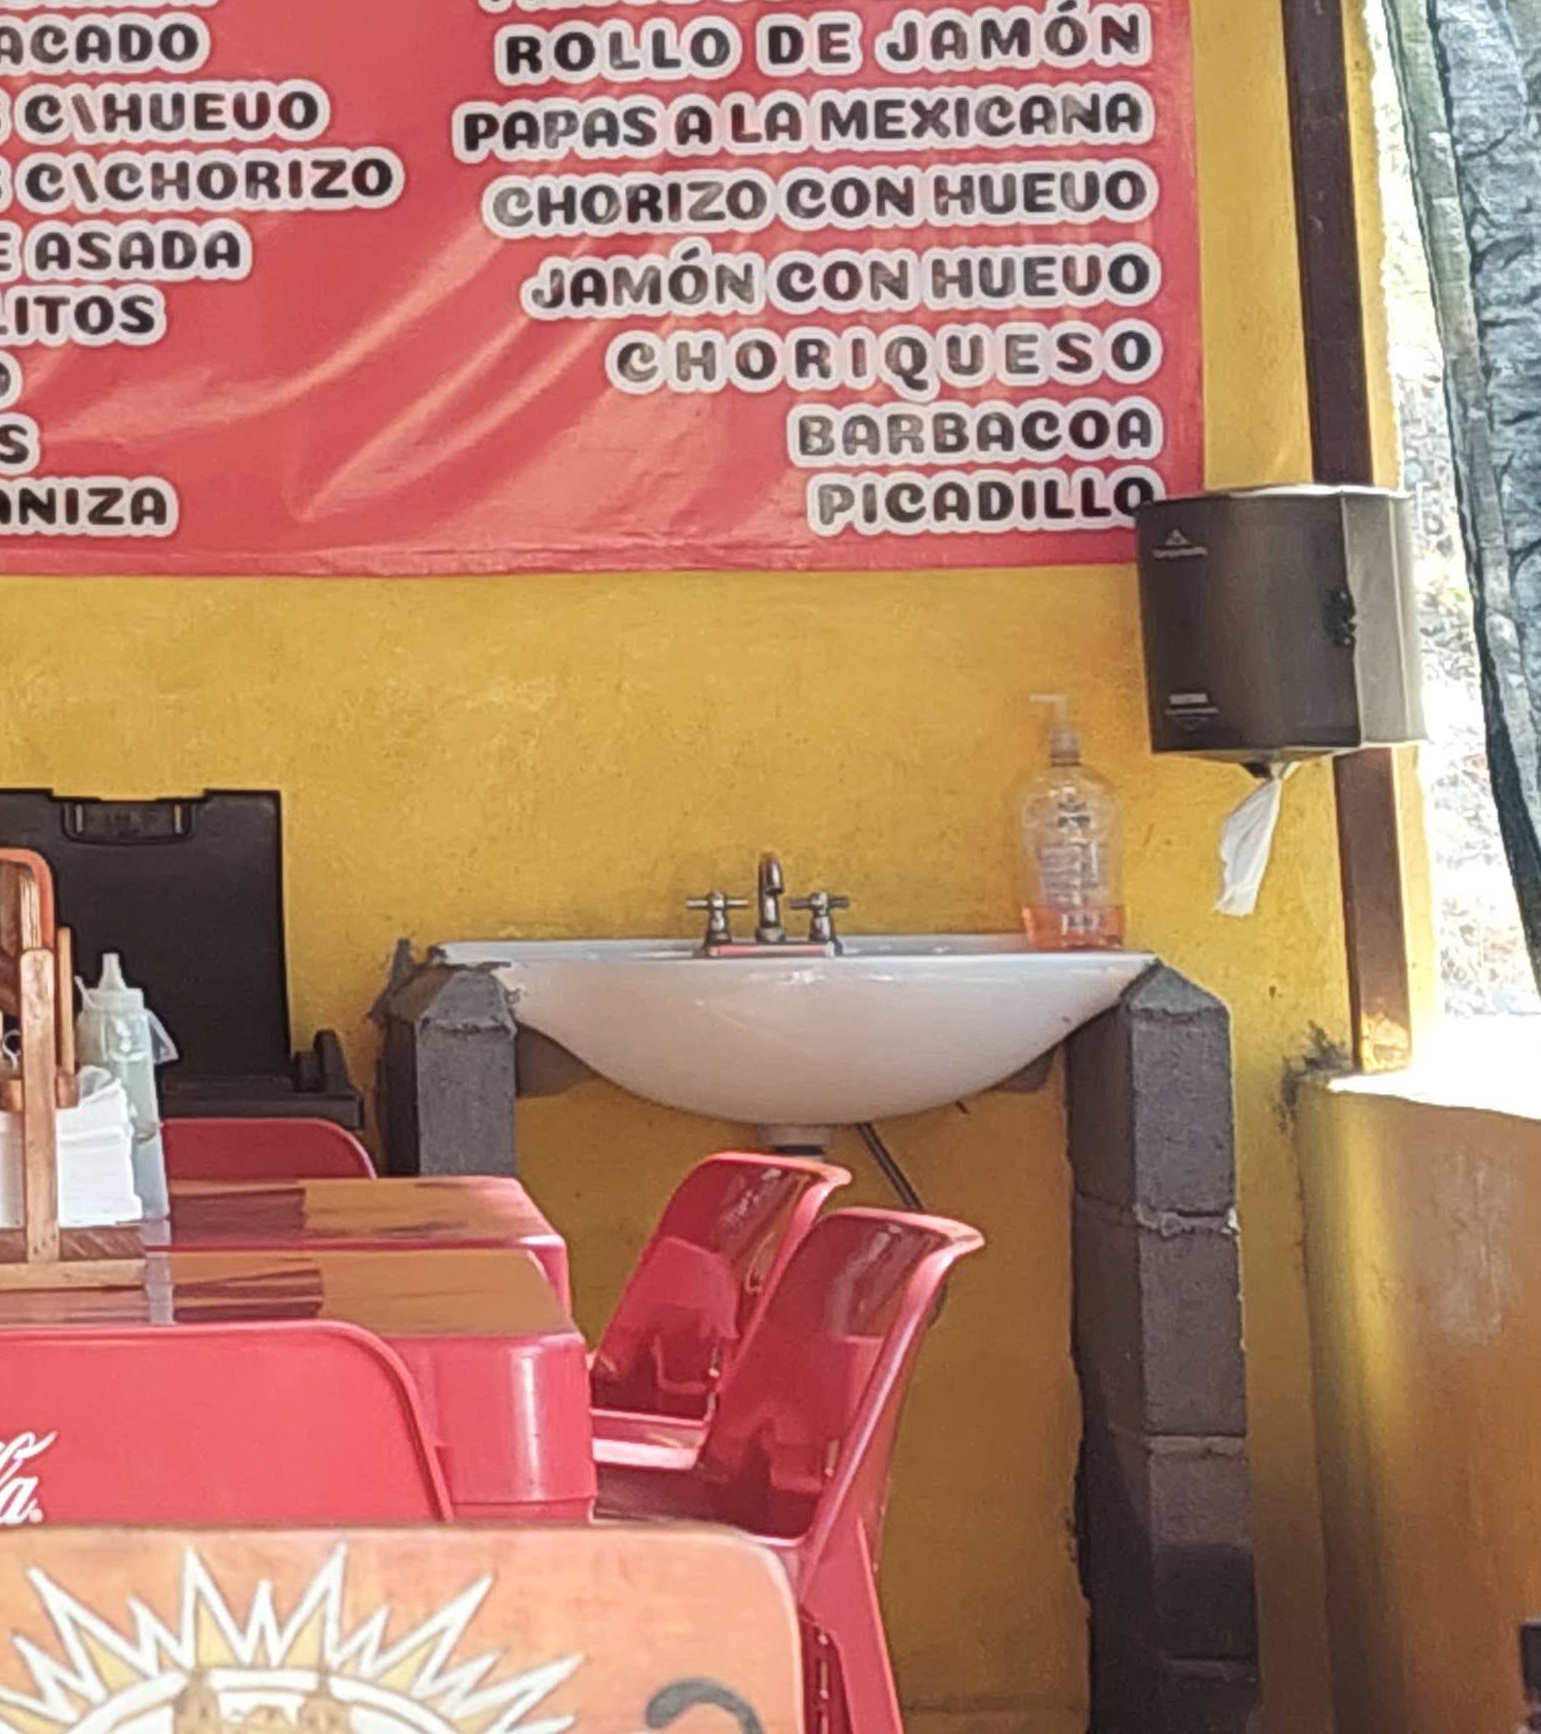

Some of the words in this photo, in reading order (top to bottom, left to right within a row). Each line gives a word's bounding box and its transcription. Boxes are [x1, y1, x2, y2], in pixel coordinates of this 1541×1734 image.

[505, 26, 732, 74] ROLLO
[767, 22, 852, 65] DE
[463, 104, 657, 152] PAPAS
[674, 102, 713, 144] A
[729, 101, 802, 144] LA
[820, 92, 1143, 142] MEXICANA
[492, 178, 767, 228] CHORIZO
[786, 174, 915, 220] CON
[34, 228, 242, 271] ASADA
[531, 247, 755, 309] JAMÓN
[776, 259, 909, 304] CON
[616, 329, 1152, 390] CHORIQUESO
[798, 407, 1152, 456] BARBACOA
[818, 478, 1153, 525] PICADILLO
